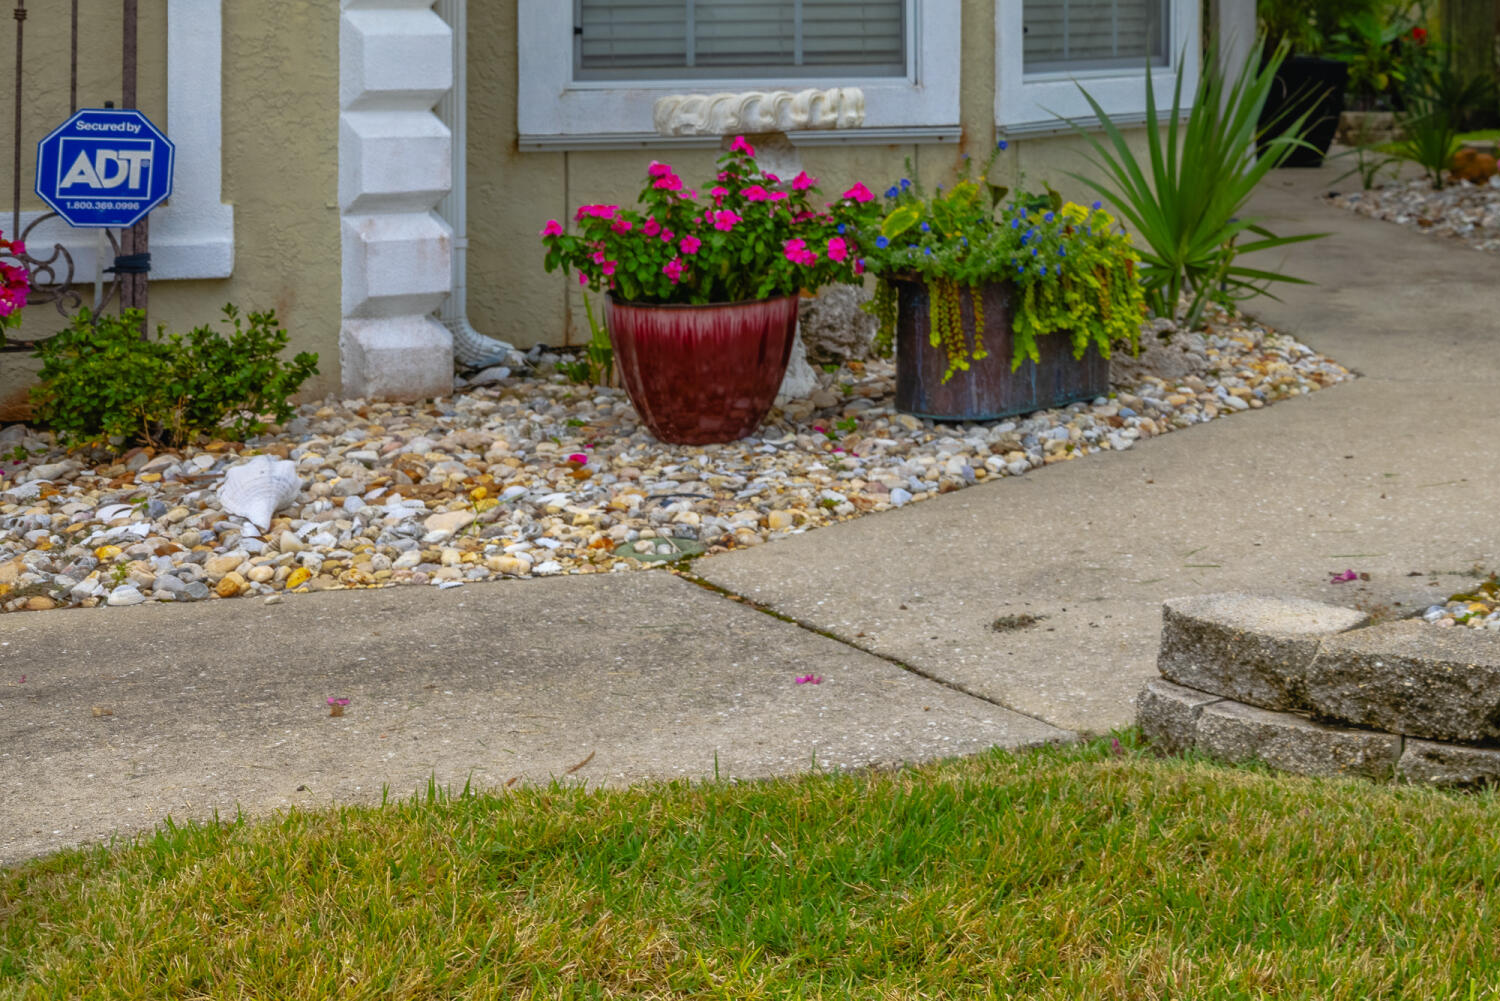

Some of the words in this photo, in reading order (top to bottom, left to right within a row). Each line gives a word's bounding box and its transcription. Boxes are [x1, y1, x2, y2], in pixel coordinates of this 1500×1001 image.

[75, 120, 125, 131] Secured
[126, 122, 141, 133] by
[59, 149, 151, 189] ADT
